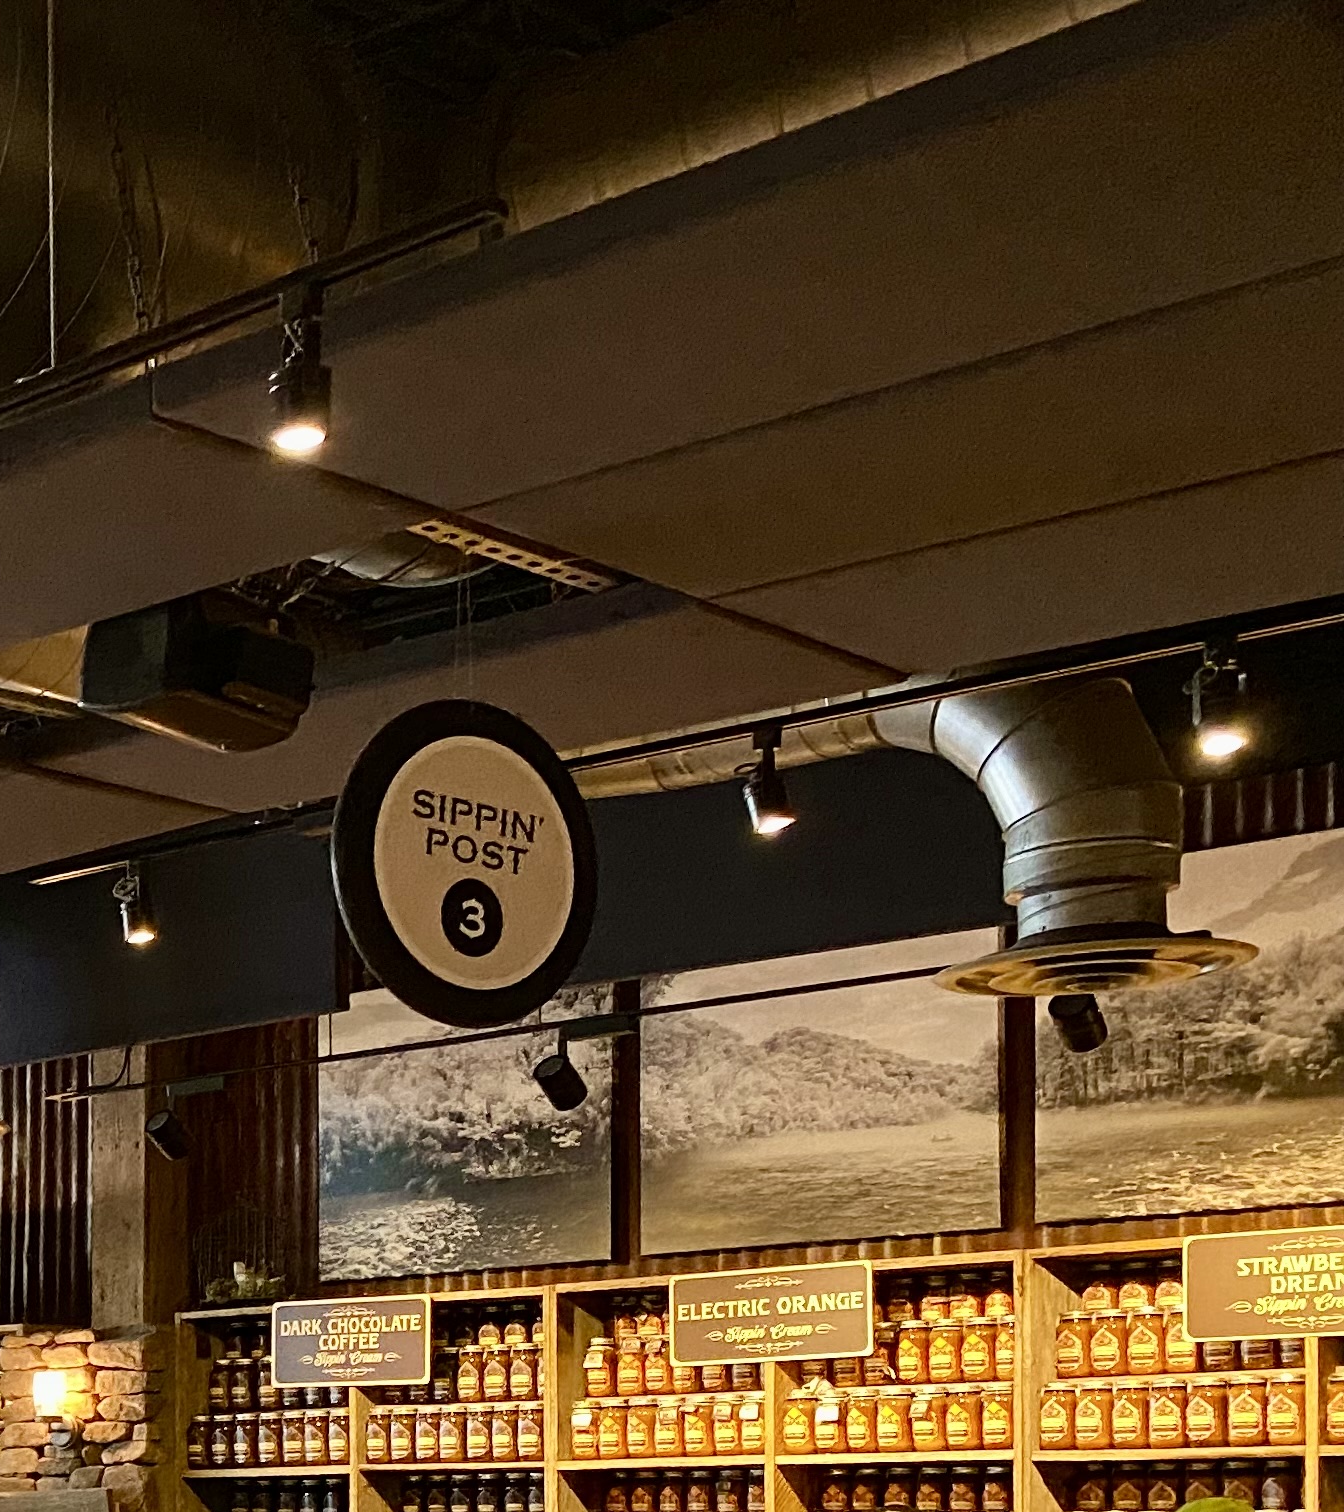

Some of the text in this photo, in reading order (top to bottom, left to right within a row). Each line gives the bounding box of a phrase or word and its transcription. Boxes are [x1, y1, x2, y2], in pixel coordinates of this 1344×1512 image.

[413, 790, 544, 843] SIPPIN'
[426, 828, 528, 875] POST
[459, 899, 485, 938] 3
[677, 1291, 864, 1322] ELECTRIC ORANGE
[280, 1314, 422, 1337] DARK CHOCOLATE
[769, 1323, 813, 1340] Cream
[318, 1332, 380, 1350] COFFEE
[348, 1351, 383, 1366] Cream
